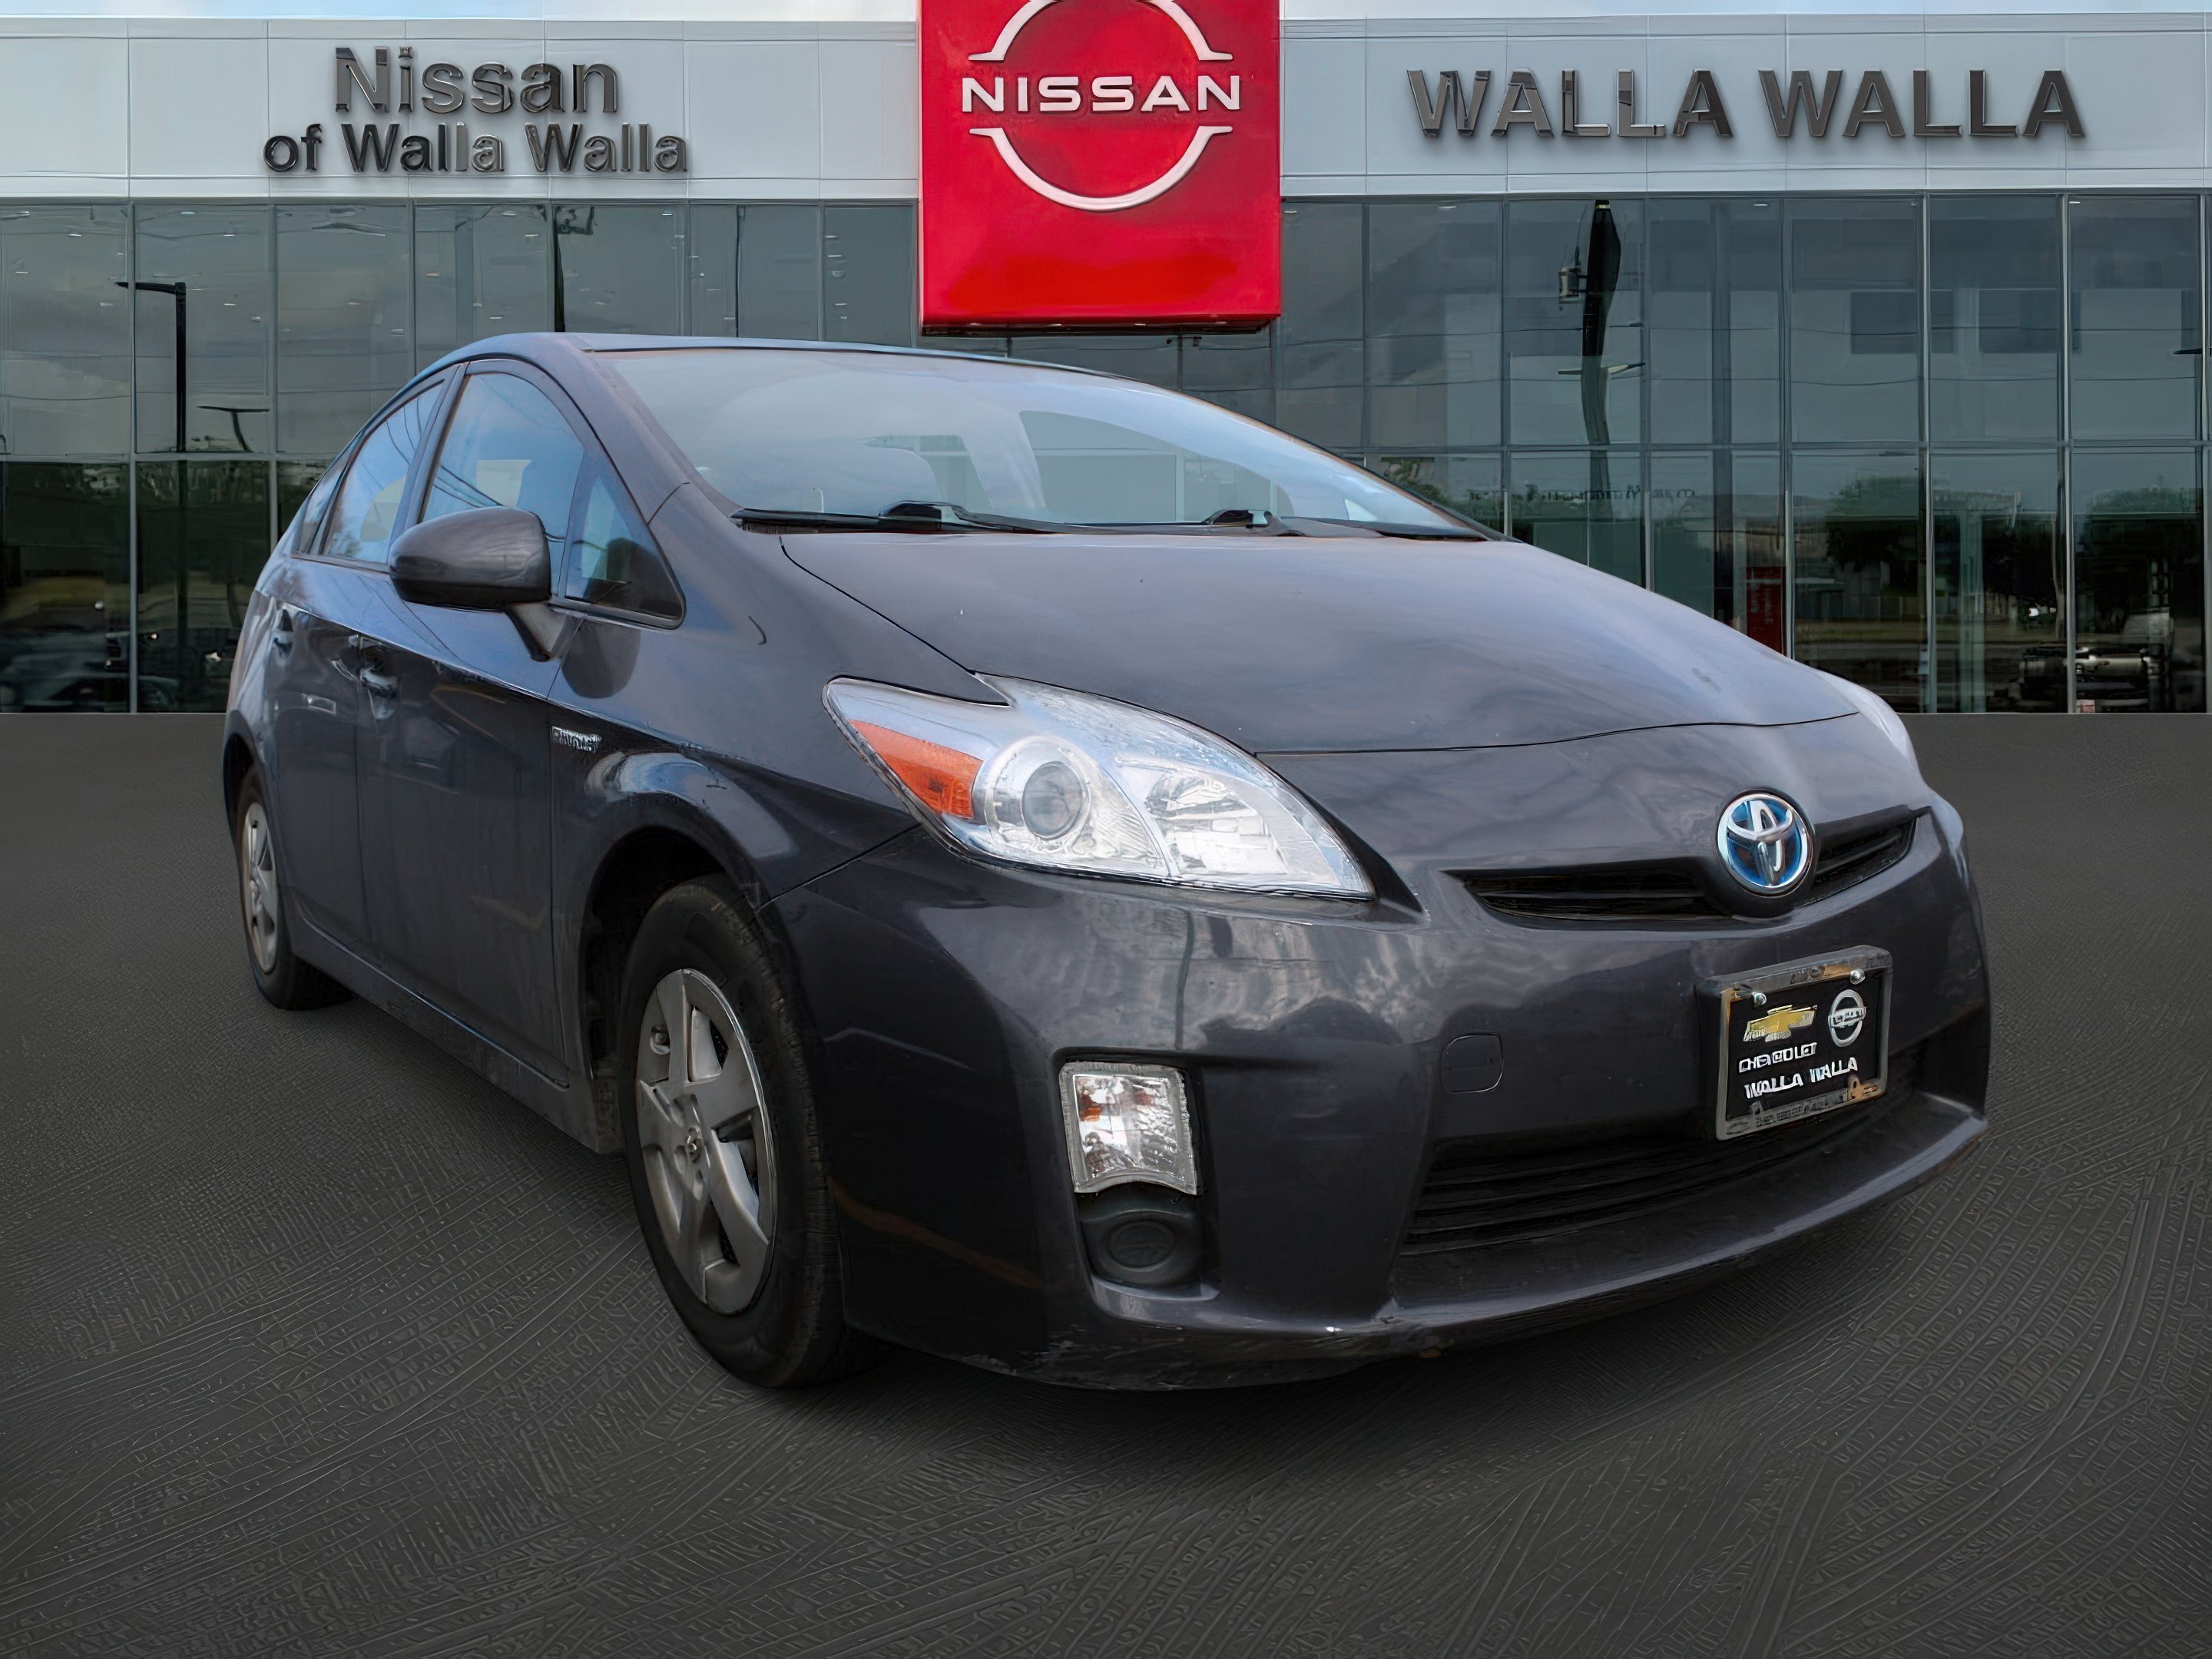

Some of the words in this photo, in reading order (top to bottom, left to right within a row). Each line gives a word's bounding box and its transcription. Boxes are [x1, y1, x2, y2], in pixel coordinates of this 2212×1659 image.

[334, 45, 619, 114] Nissan
[962, 75, 1240, 112] NISSAN
[1406, 68, 1734, 138] WALLA
[1757, 68, 2086, 138] WALLA
[263, 123, 323, 172] of
[340, 123, 505, 172] Walla
[524, 123, 687, 172] Walla
[1743, 1072, 1804, 1099] WALLA
[1809, 1056, 1859, 1084] WALLA
